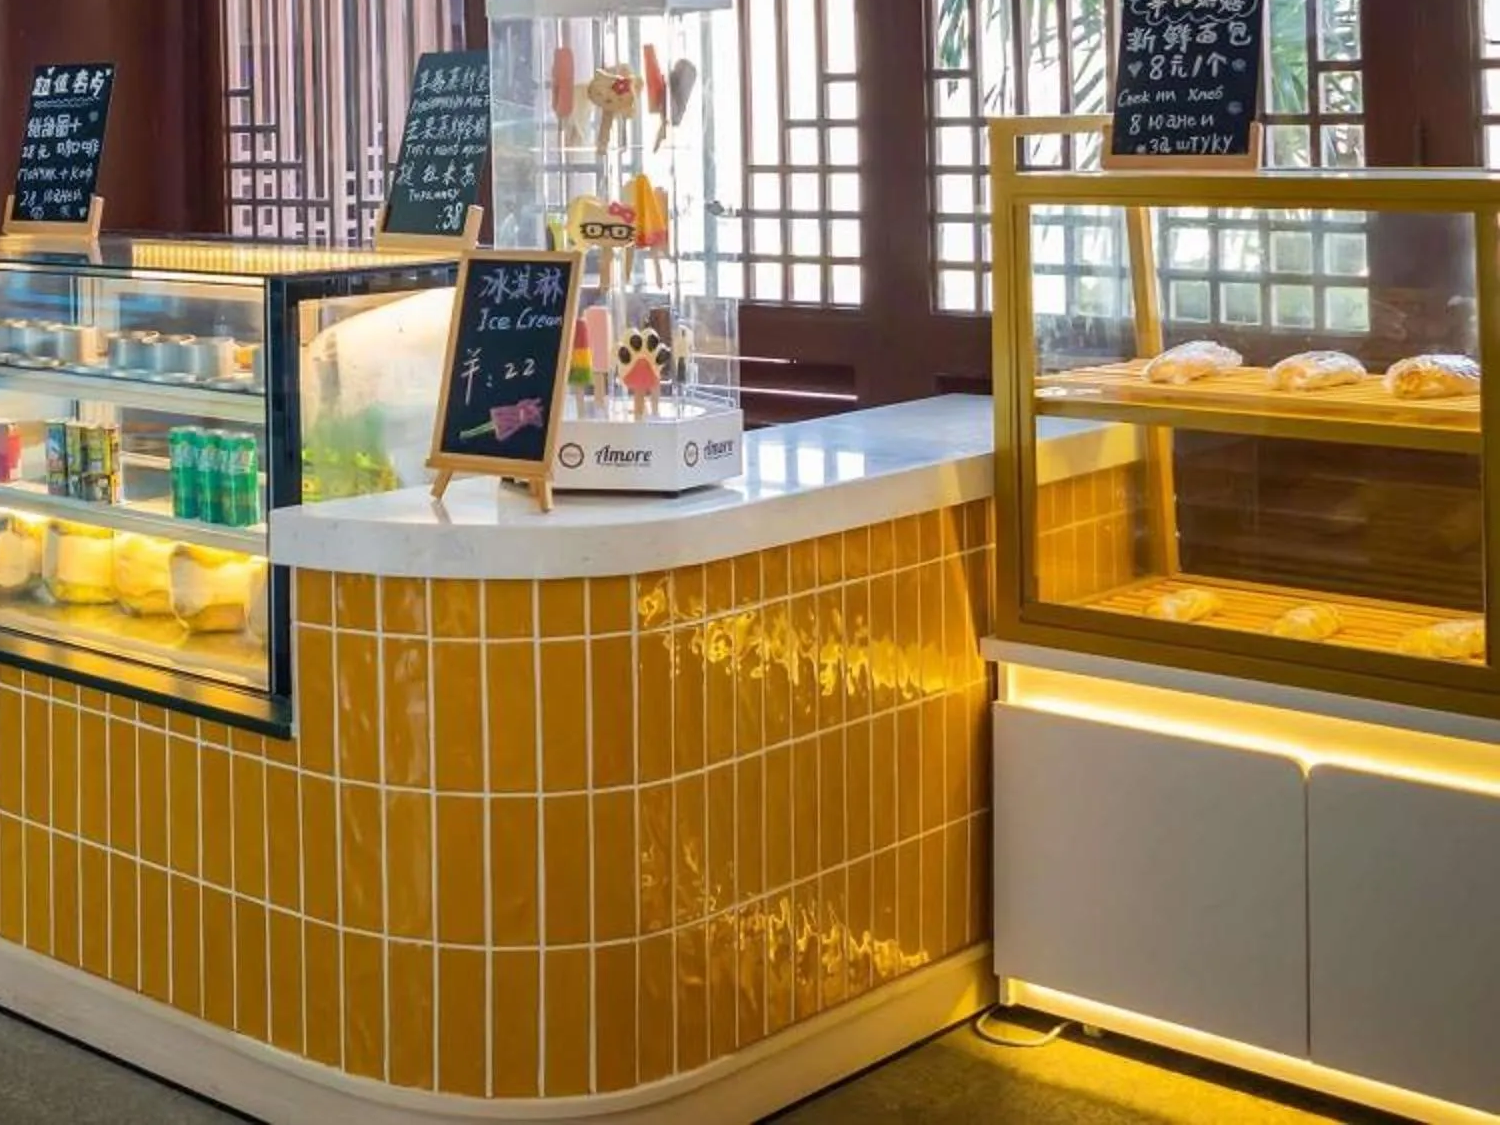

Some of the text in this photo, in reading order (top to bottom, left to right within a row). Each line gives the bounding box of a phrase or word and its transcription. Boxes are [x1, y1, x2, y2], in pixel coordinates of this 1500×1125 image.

[1126, 21, 1252, 54] 新鲜面包
[1128, 114, 1142, 136] 8
[56, 138, 100, 158] 咖啡
[478, 264, 564, 306] 冰淇淋
[476, 308, 511, 332] Ice
[594, 444, 653, 465] Amore
